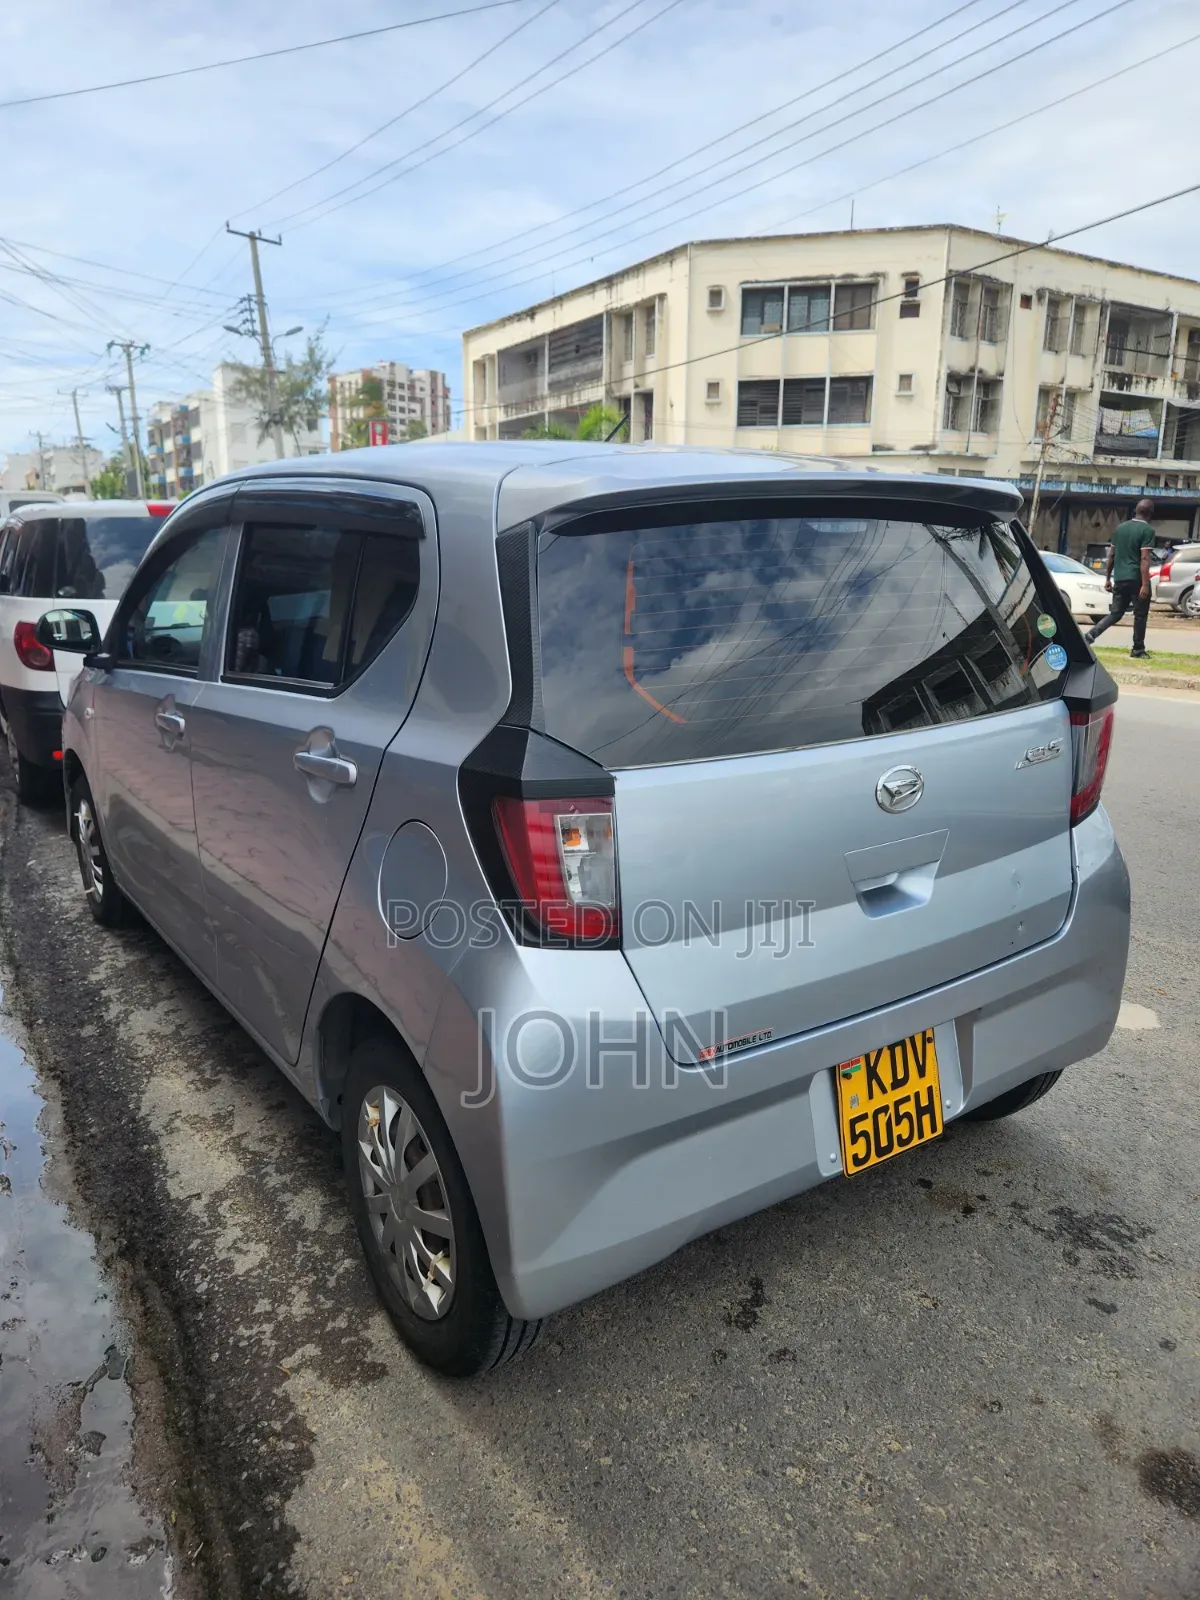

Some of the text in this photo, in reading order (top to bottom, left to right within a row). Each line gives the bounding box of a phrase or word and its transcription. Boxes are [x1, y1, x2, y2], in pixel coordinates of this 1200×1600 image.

[716, 1035, 757, 1053] AUTOMOBILE
[864, 1030, 927, 1100] KDV
[849, 1085, 938, 1167] 505H
